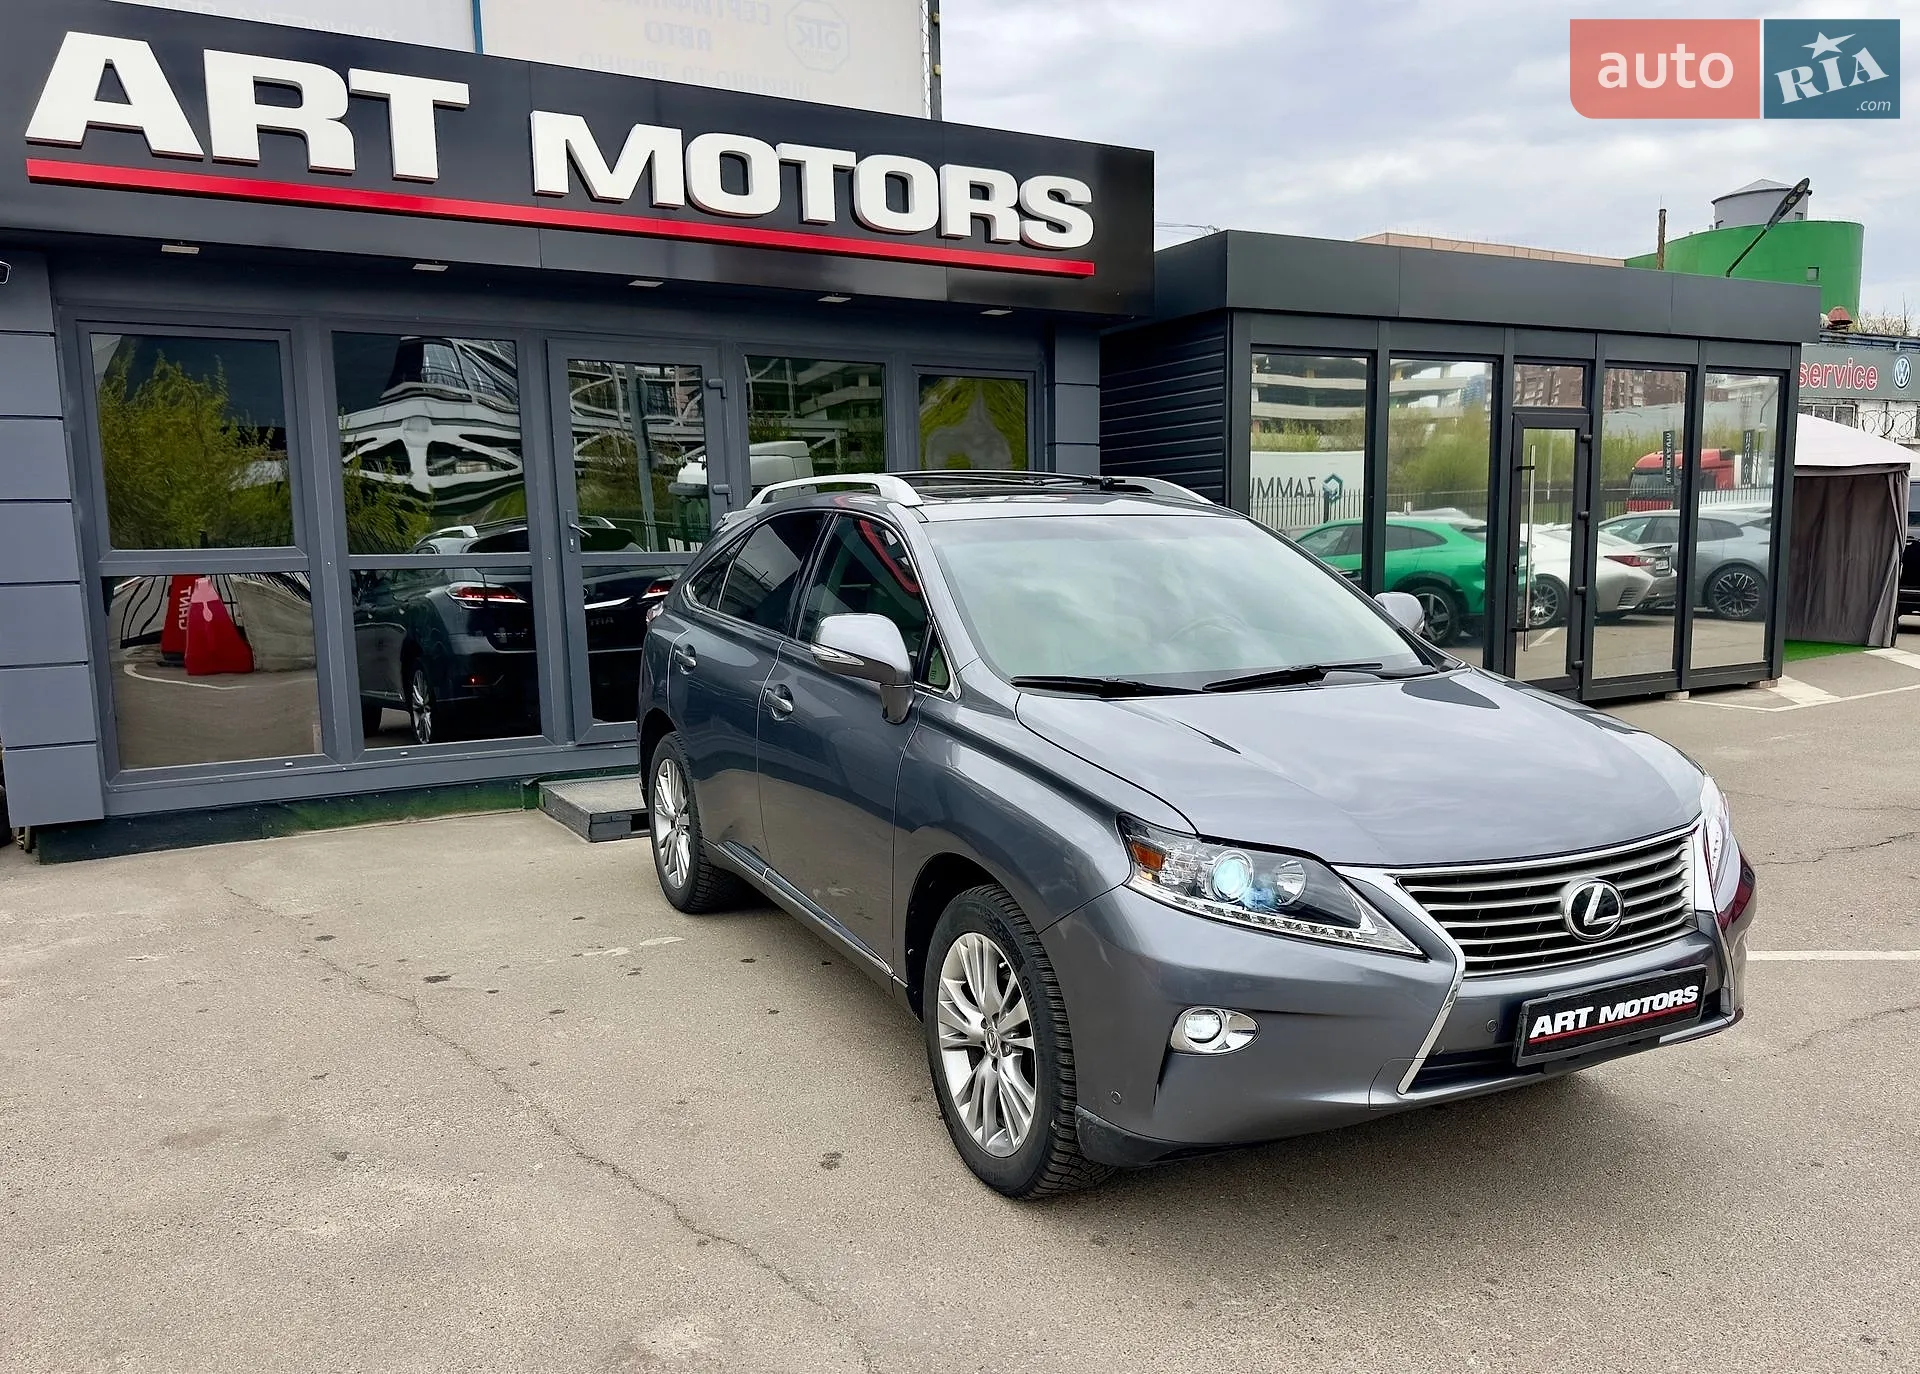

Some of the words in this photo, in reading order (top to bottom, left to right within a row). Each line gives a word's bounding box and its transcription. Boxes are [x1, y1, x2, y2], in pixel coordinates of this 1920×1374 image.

[25, 31, 469, 183] ART
[530, 110, 1094, 249] MOTORS
[1799, 357, 1878, 391] service
[1529, 1006, 1594, 1039] ART
[1599, 985, 1699, 1023] MOTORS
